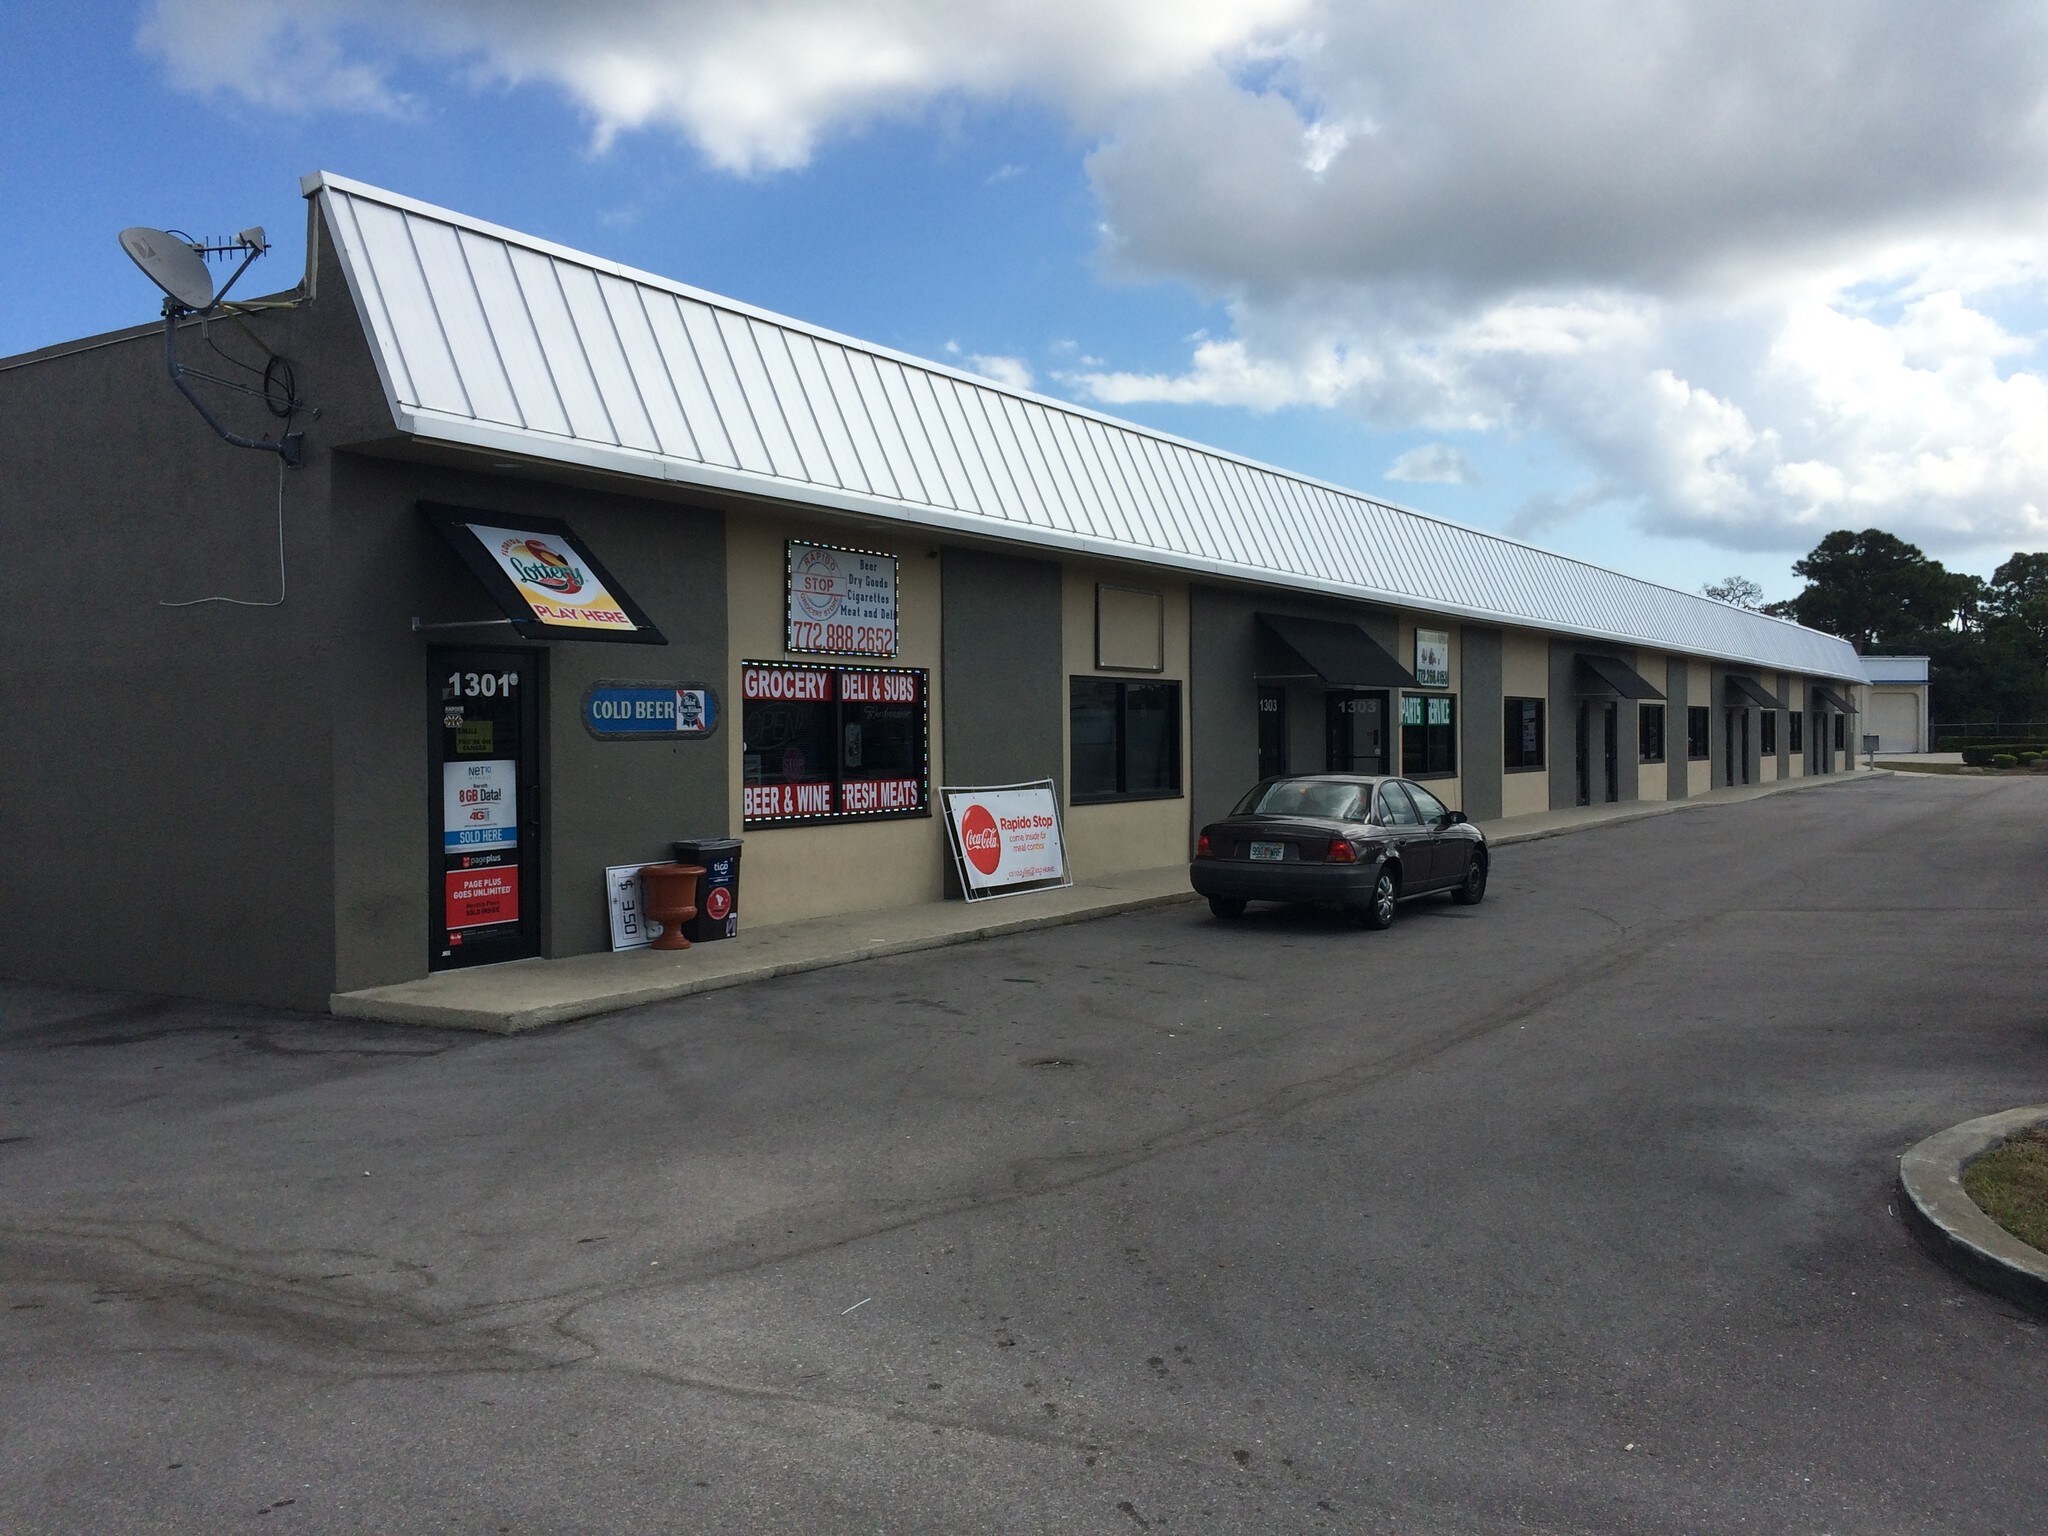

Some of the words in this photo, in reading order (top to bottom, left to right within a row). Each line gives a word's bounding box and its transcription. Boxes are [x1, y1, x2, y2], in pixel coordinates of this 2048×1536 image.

[501, 538, 523, 557] FLORIDA
[804, 551, 836, 572] RAPIDO
[860, 559, 878, 572] Beer
[510, 557, 584, 587] Lottery
[804, 577, 834, 592] STOP
[848, 573, 863, 588] Dry
[865, 576, 888, 589] Goods
[847, 590, 890, 604] Cigarettes
[533, 604, 578, 620] PLAY
[581, 609, 629, 624] HERE
[840, 605, 861, 617] Meat
[863, 608, 878, 619] and
[793, 621, 893, 653] 772.888.2652
[448, 672, 511, 697] 1301
[745, 670, 828, 699] GROCERY
[842, 673, 869, 700] DELI
[872, 675, 881, 701] &
[883, 675, 914, 701] SUBS
[592, 701, 631, 719] COLD
[636, 701, 675, 719] BEER
[1259, 699, 1278, 712] 1303
[1338, 700, 1377, 713] 1303
[1401, 697, 1421, 724] PARTS
[480, 788, 502, 801] Data!
[744, 786, 780, 815] BEER
[783, 785, 793, 813] &
[796, 784, 830, 812] WINE
[880, 780, 918, 808] MEATS
[1000, 816, 1032, 832] Rapido
[1033, 815, 1053, 829] Stop
[459, 830, 481, 844] SOLD
[482, 829, 503, 842] HERE
[464, 880, 482, 889] PAGE
[484, 878, 502, 886] PLUS
[453, 890, 472, 899] GOES
[473, 886, 511, 897] UNLIMITED
